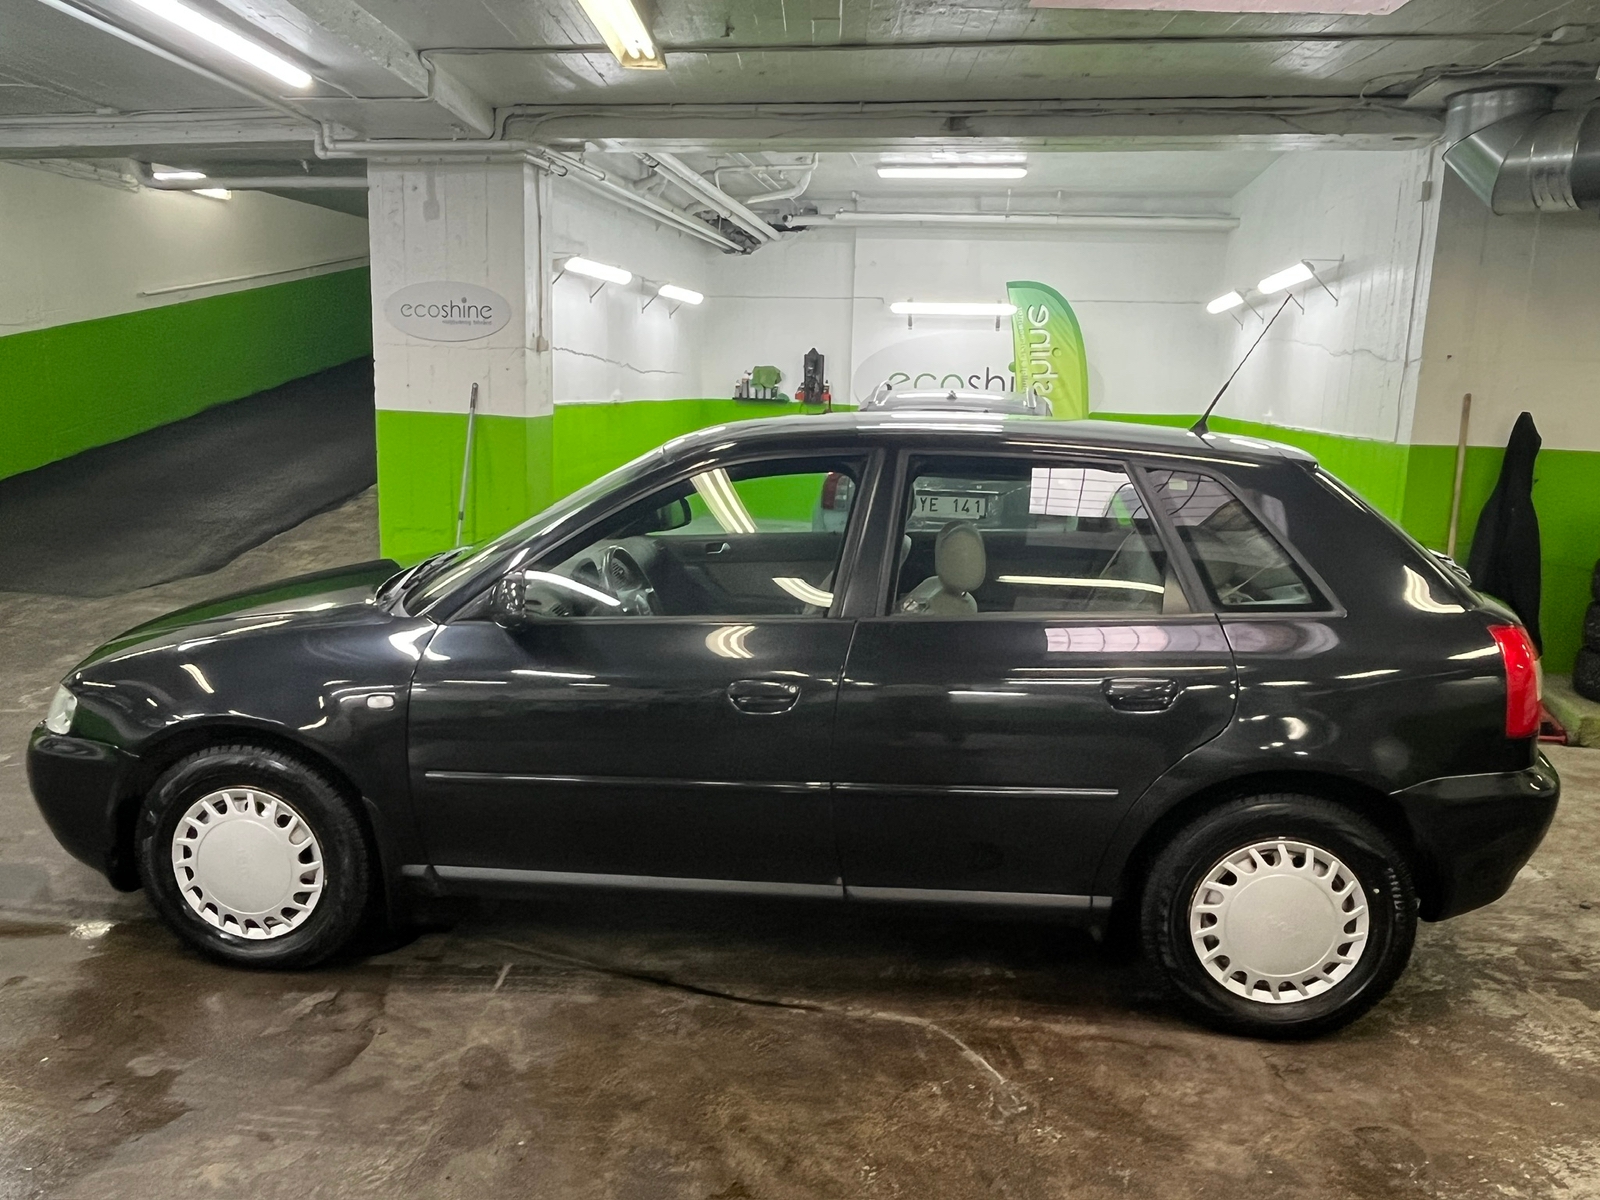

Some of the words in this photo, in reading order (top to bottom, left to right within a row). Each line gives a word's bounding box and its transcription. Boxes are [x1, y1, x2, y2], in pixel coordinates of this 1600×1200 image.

[400, 297, 492, 319] ecoshine
[888, 361, 1015, 393] ecoshi
[920, 497, 938, 512] YE
[953, 498, 980, 513] 141
